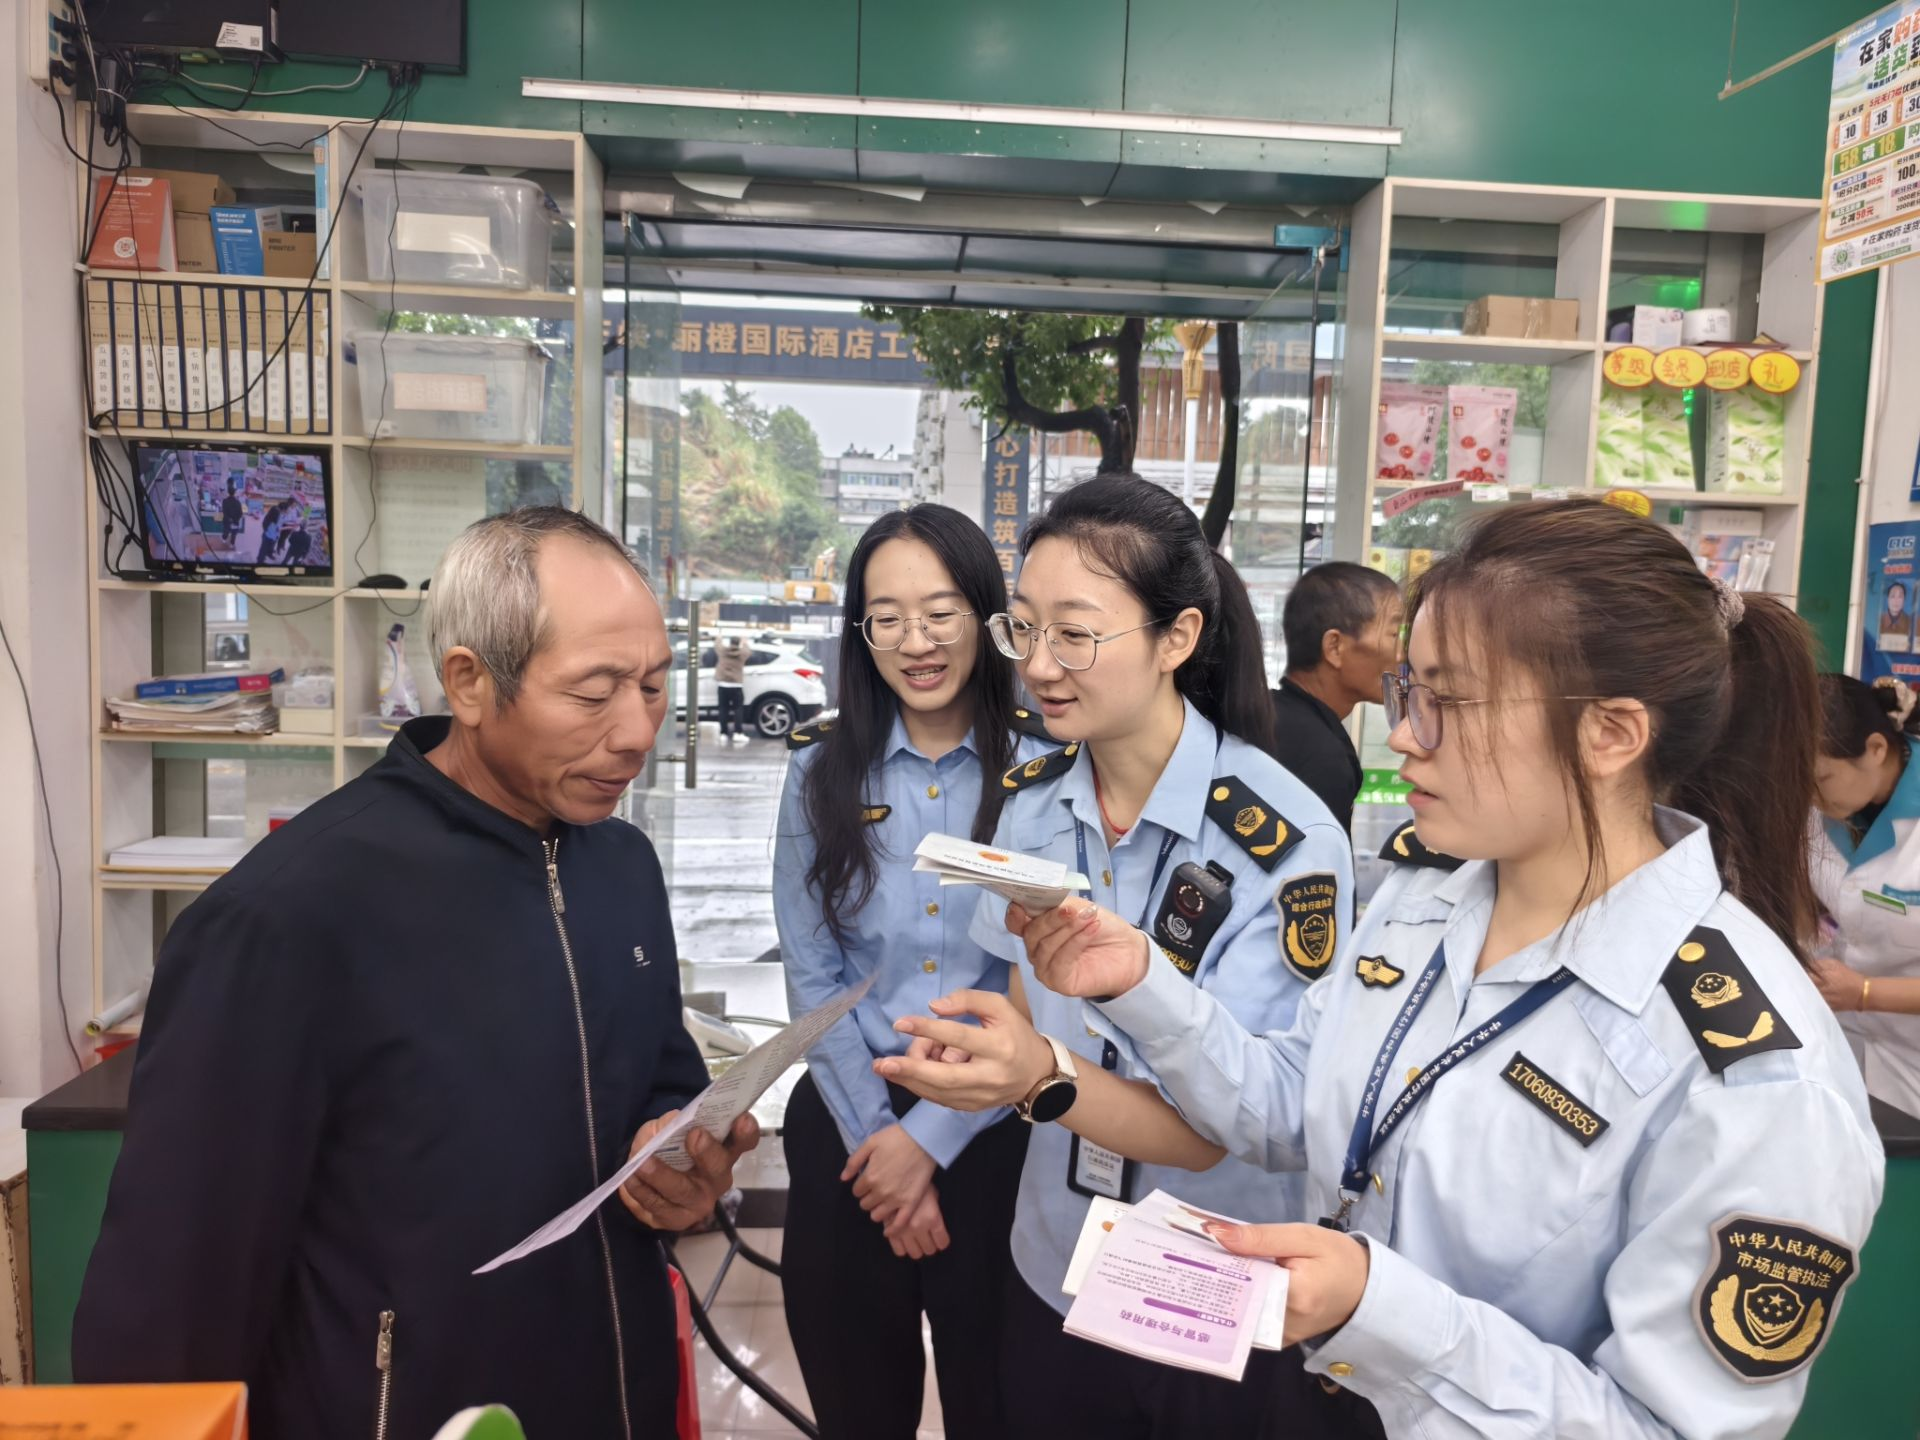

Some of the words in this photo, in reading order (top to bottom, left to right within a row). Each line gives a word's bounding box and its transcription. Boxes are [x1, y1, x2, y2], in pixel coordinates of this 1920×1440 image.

[1869, 80, 1920, 107] 5元无门槛优惠
[1845, 124, 1856, 138] 10
[1877, 110, 1888, 125] 18
[992, 433, 1020, 597] 心打造筑百
[1283, 884, 1335, 904] 中华人民共和国
[1508, 1062, 1599, 1137] 17060930353
[1728, 1231, 1848, 1275] 中华人民共和国
[1737, 1251, 1832, 1289] 市场监管执法
[1117, 1308, 1211, 1344] 感冒与合理用药
